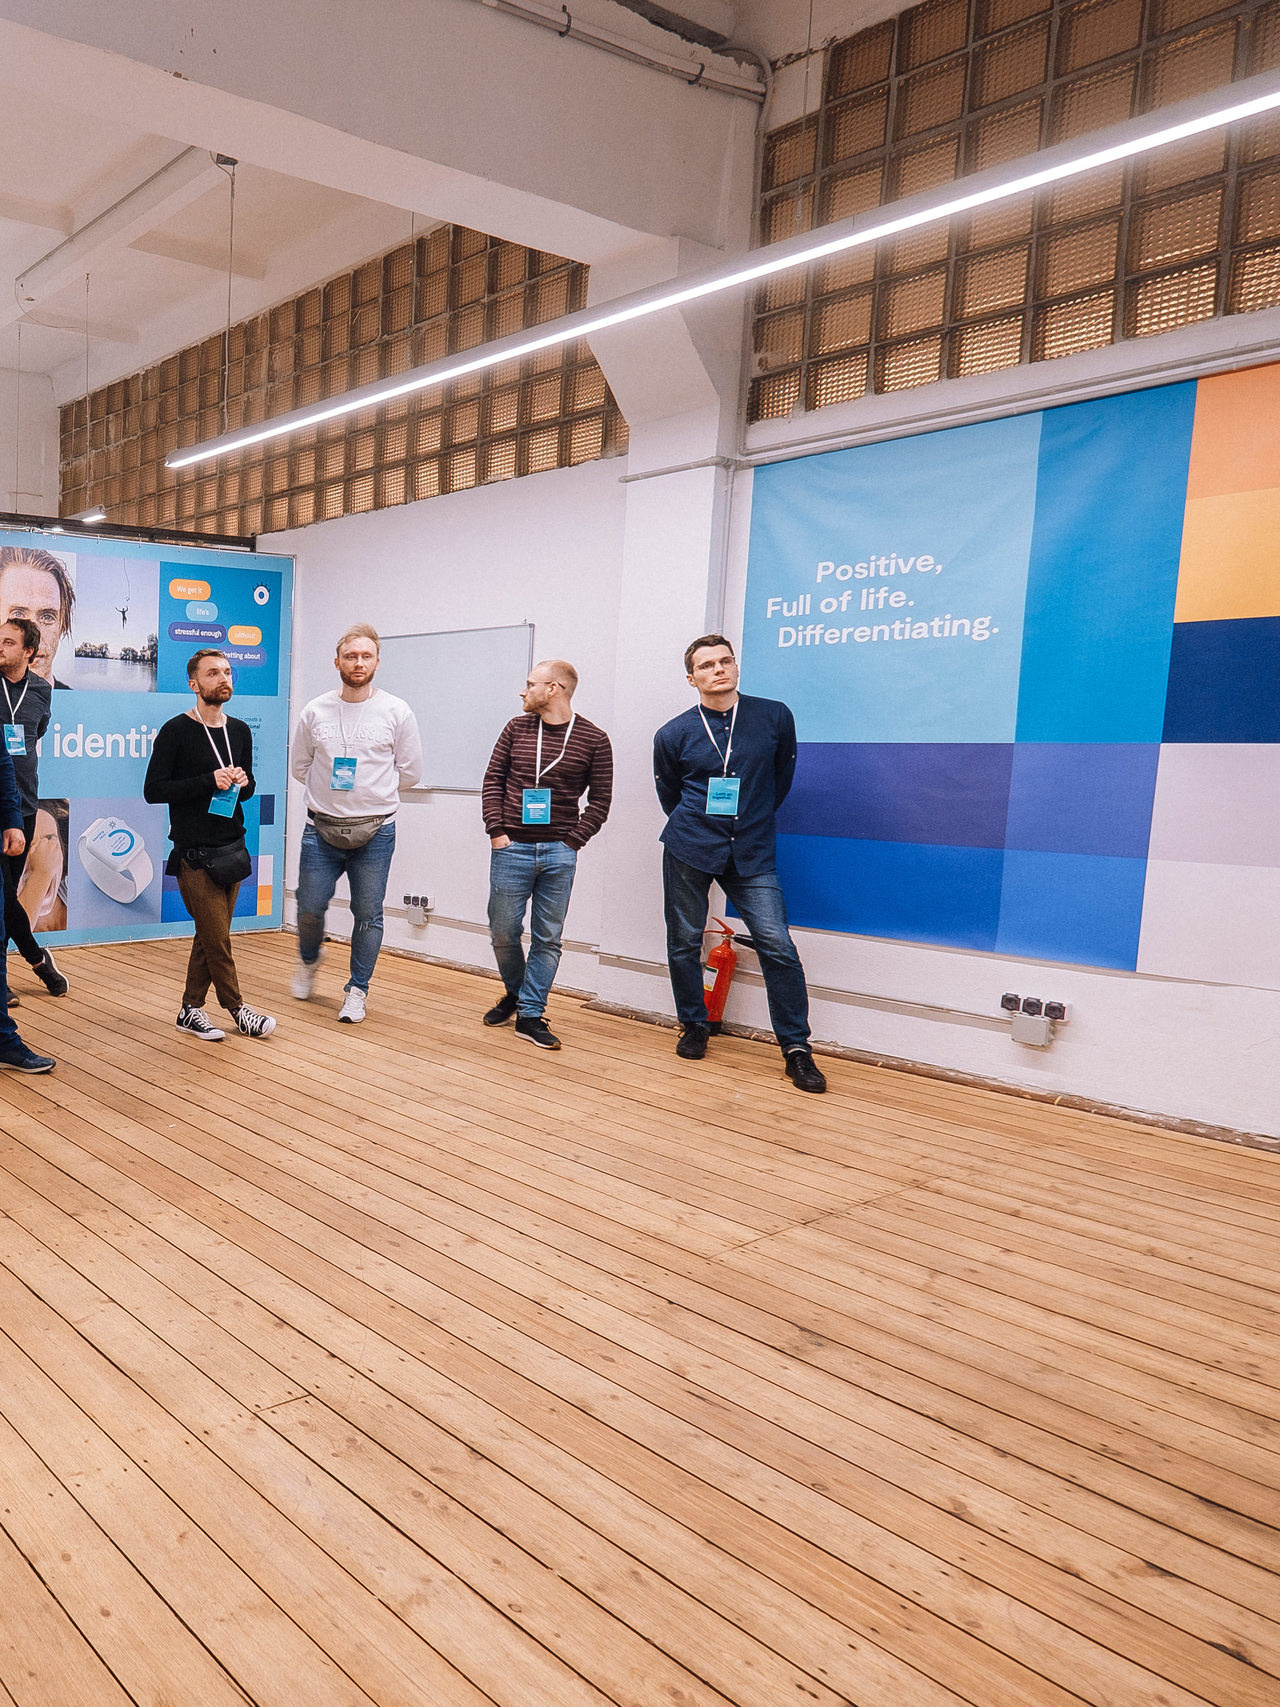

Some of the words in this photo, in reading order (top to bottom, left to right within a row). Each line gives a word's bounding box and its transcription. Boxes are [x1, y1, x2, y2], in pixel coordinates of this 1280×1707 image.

[816, 553, 943, 583] Positive,
[766, 594, 811, 619] Full
[819, 590, 852, 615] of
[860, 586, 915, 611] life.
[174, 628, 200, 636] stressful
[200, 629, 222, 639] enough
[778, 613, 1000, 648] Differentiating.
[244, 652, 261, 660] about
[53, 722, 159, 758] identit
